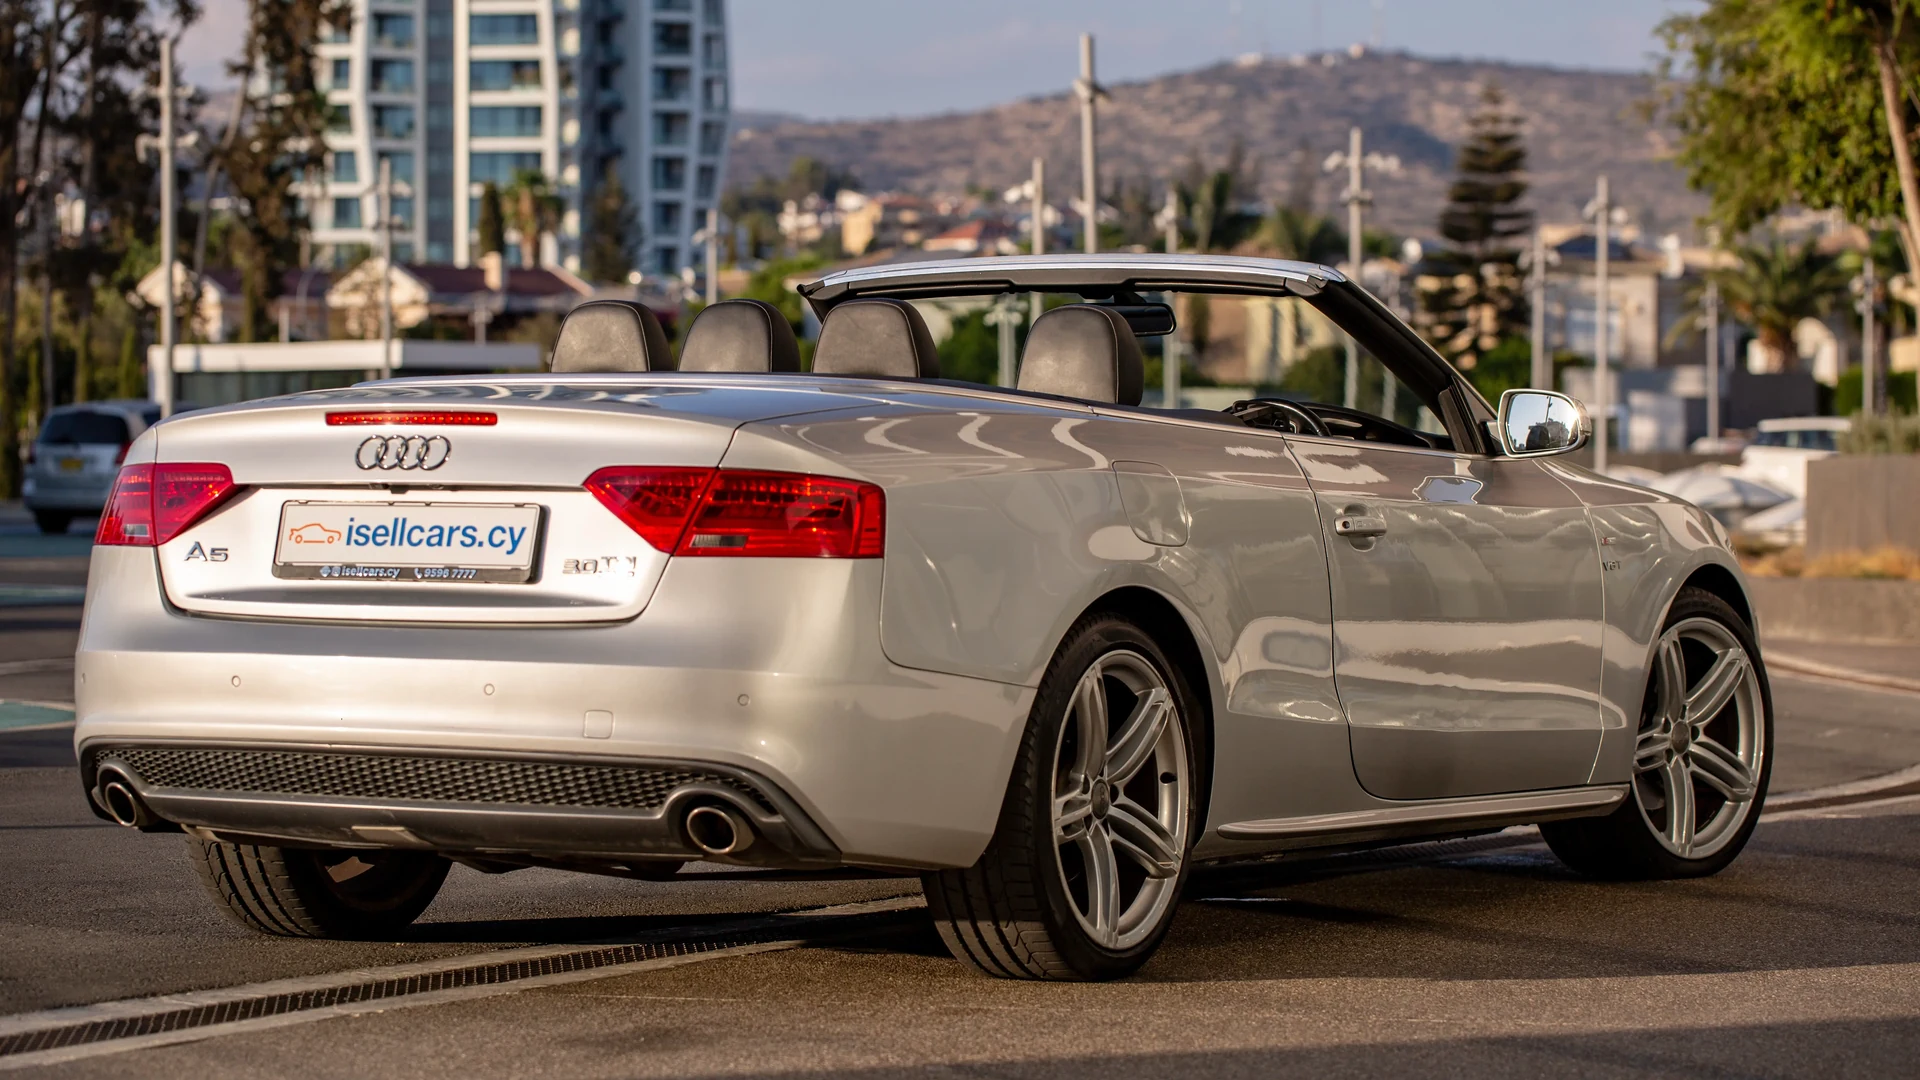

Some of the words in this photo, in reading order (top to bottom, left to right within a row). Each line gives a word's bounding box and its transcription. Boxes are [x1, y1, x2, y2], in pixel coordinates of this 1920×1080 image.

[345, 517, 527, 555] isellcars.cy
[184, 541, 228, 562] A5
[342, 566, 400, 579] isellcars.cy
[452, 569, 477, 580] 7777
